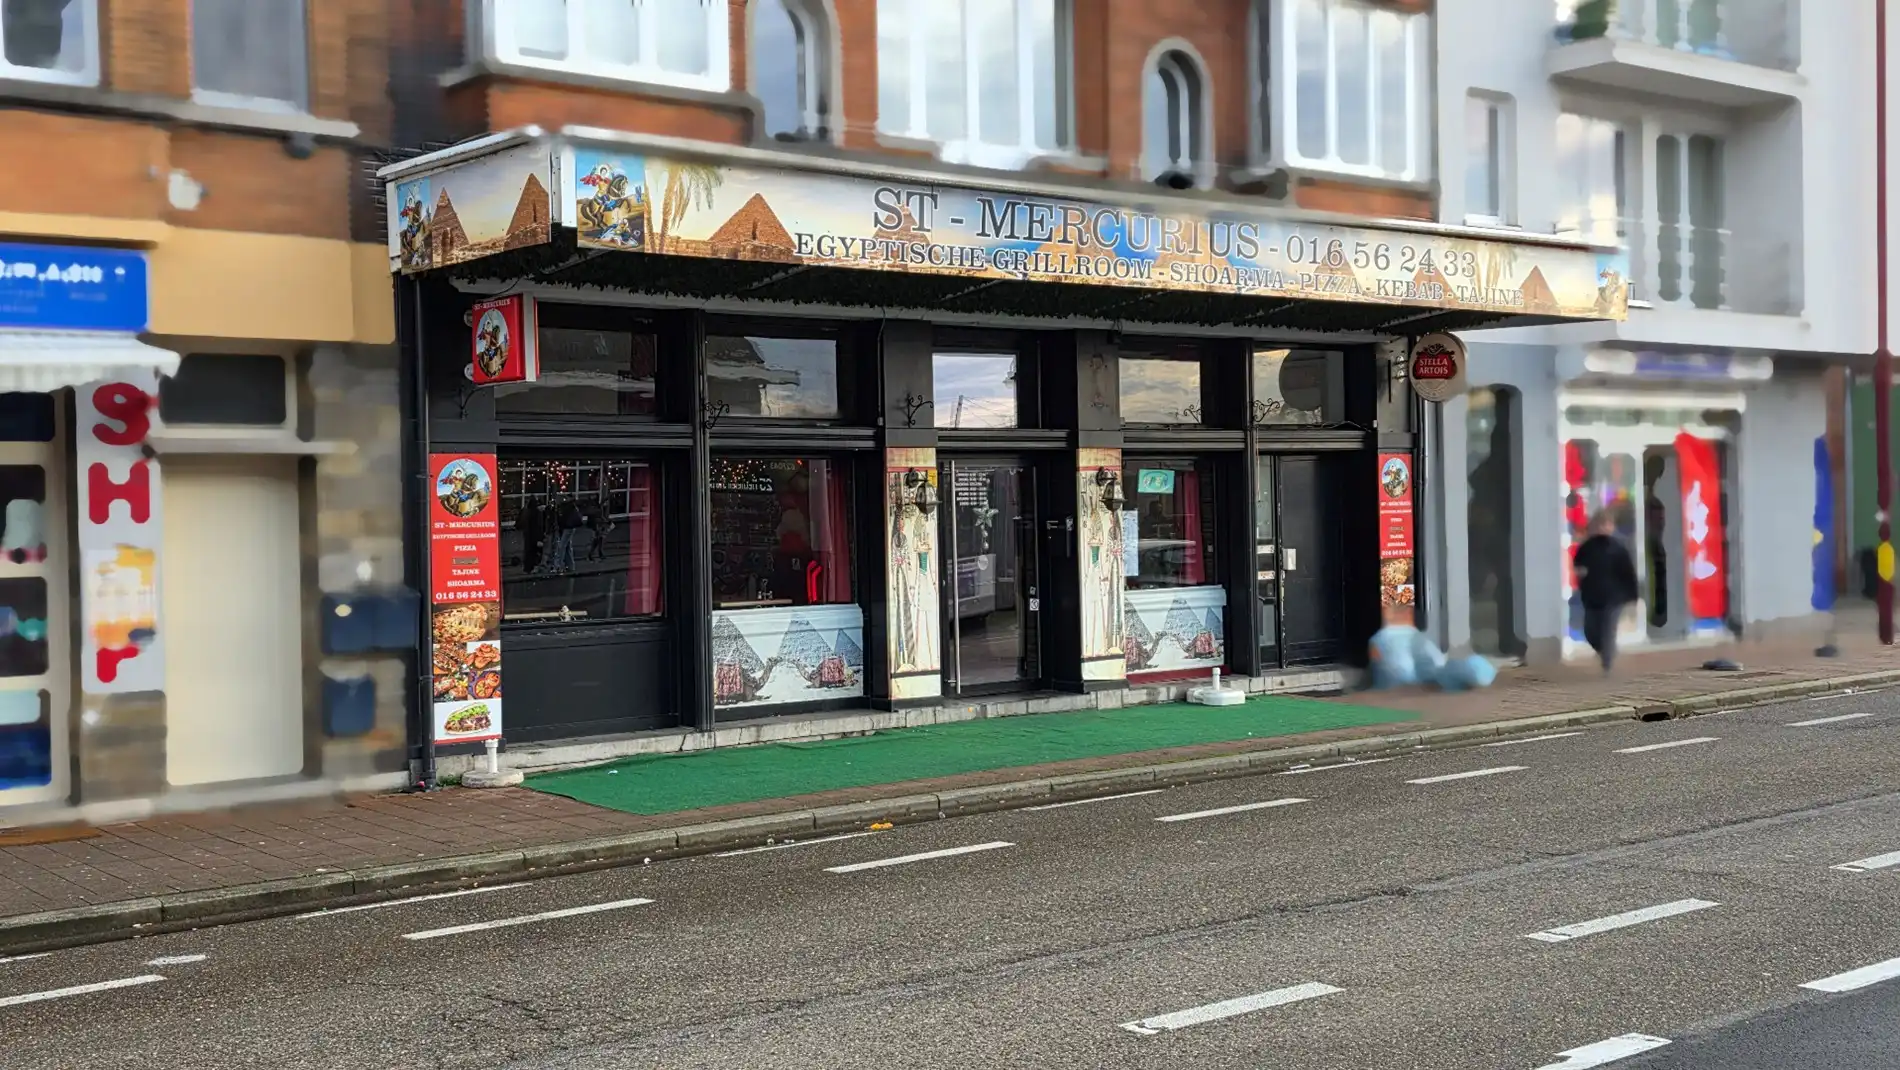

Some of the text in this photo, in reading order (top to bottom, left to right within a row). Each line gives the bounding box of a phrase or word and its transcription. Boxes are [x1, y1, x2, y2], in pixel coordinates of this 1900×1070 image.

[874, 187, 939, 233] ST
[976, 197, 1260, 259] MERCURIUS
[1287, 234, 1344, 267] 016
[1353, 241, 1391, 271] 56
[1400, 245, 1435, 275] 24
[1444, 250, 1476, 278] 33
[795, 232, 985, 269] EGYPTISCHE
[992, 248, 1152, 280] GRILLROOM
[1170, 262, 1284, 289] SHOARMA
[1299, 272, 1362, 295] PIZZA
[1376, 278, 1444, 301] KEBAB
[1456, 285, 1524, 307] TAJINE
[1419, 358, 1449, 366] STELLA
[1418, 366, 1449, 375] ARTOIS
[435, 590, 497, 600] 016 56 24 33
